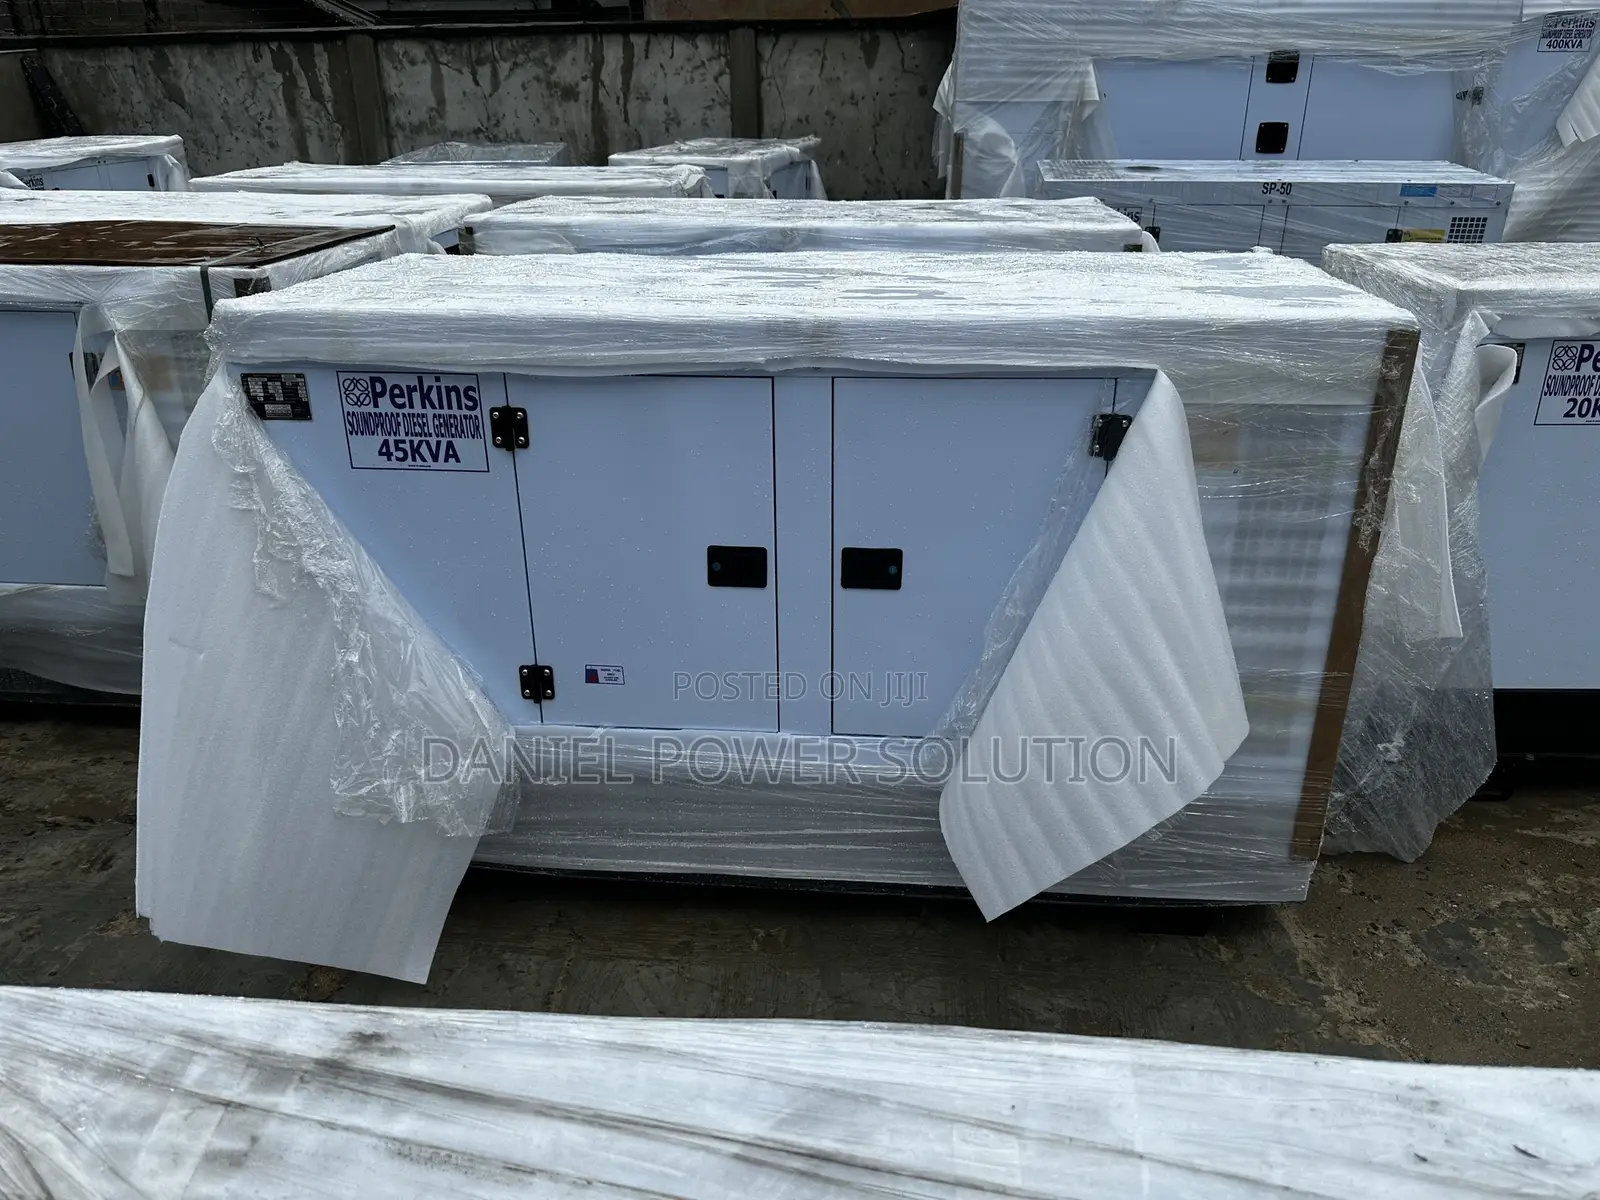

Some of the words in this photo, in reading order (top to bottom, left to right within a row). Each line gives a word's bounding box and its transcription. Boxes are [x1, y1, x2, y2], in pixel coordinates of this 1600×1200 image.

[1545, 39, 1583, 49] 400KVA
[1261, 182, 1292, 195] SP-50
[369, 376, 479, 411] Perkins
[1544, 375, 1596, 396] SOUNDPROOF
[346, 411, 401, 436] SOUNDPROOF
[401, 412, 433, 437] DIESEL
[432, 413, 482, 439] GENERATOR
[378, 439, 461, 463] 45KVA
